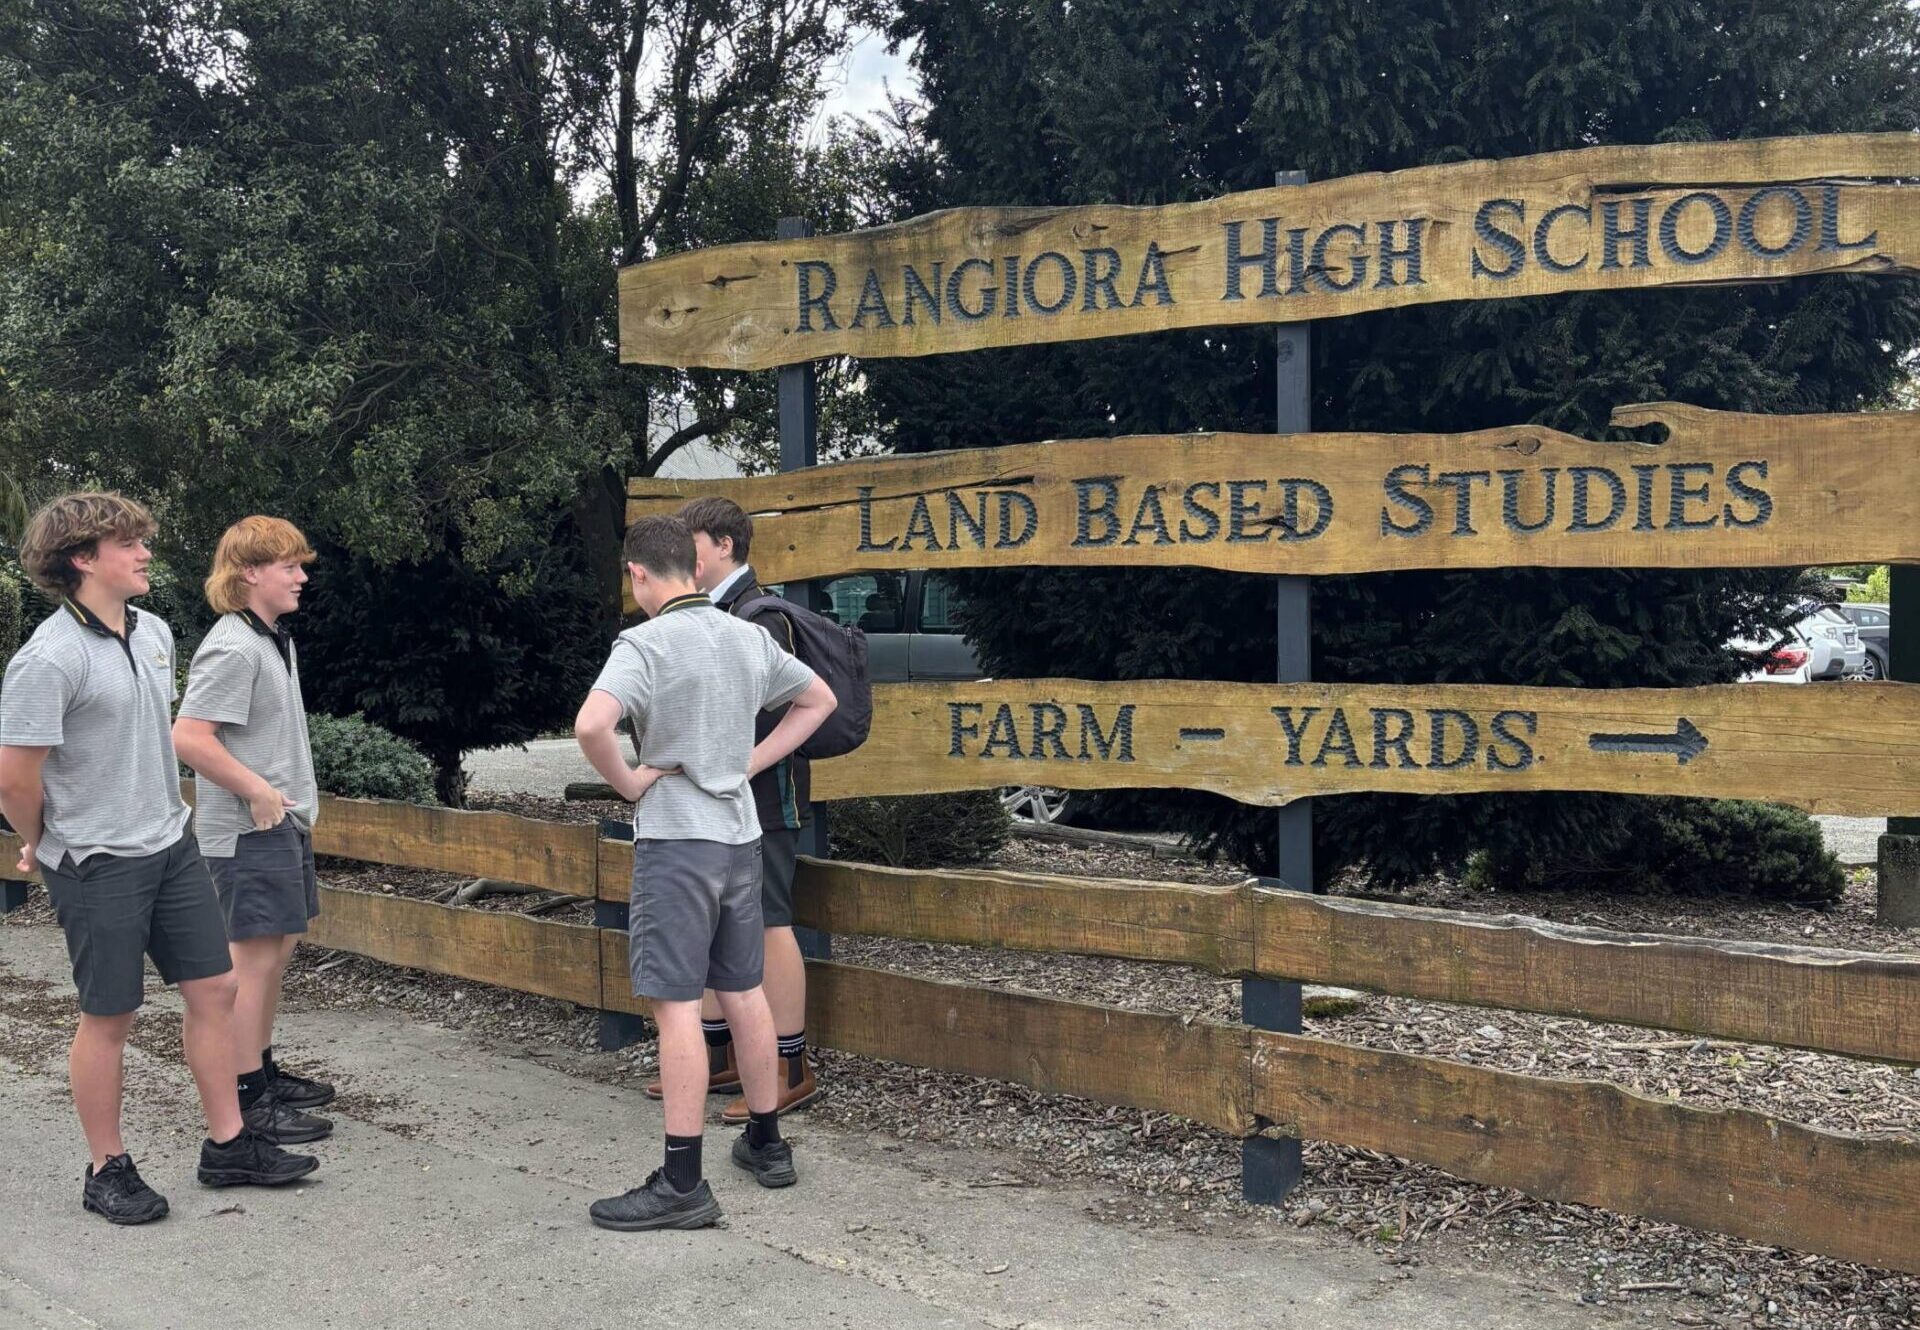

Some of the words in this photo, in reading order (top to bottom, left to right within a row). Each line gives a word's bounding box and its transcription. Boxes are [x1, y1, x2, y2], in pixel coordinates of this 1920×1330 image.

[793, 241, 1176, 332] RANGIORA
[1220, 216, 1428, 300] HIGH
[1471, 184, 1878, 283] SCHOOL
[856, 486, 1039, 552] LAND
[1070, 473, 1335, 549] BASED
[1380, 460, 1773, 537] STUDIES
[945, 701, 1137, 763] FARM
